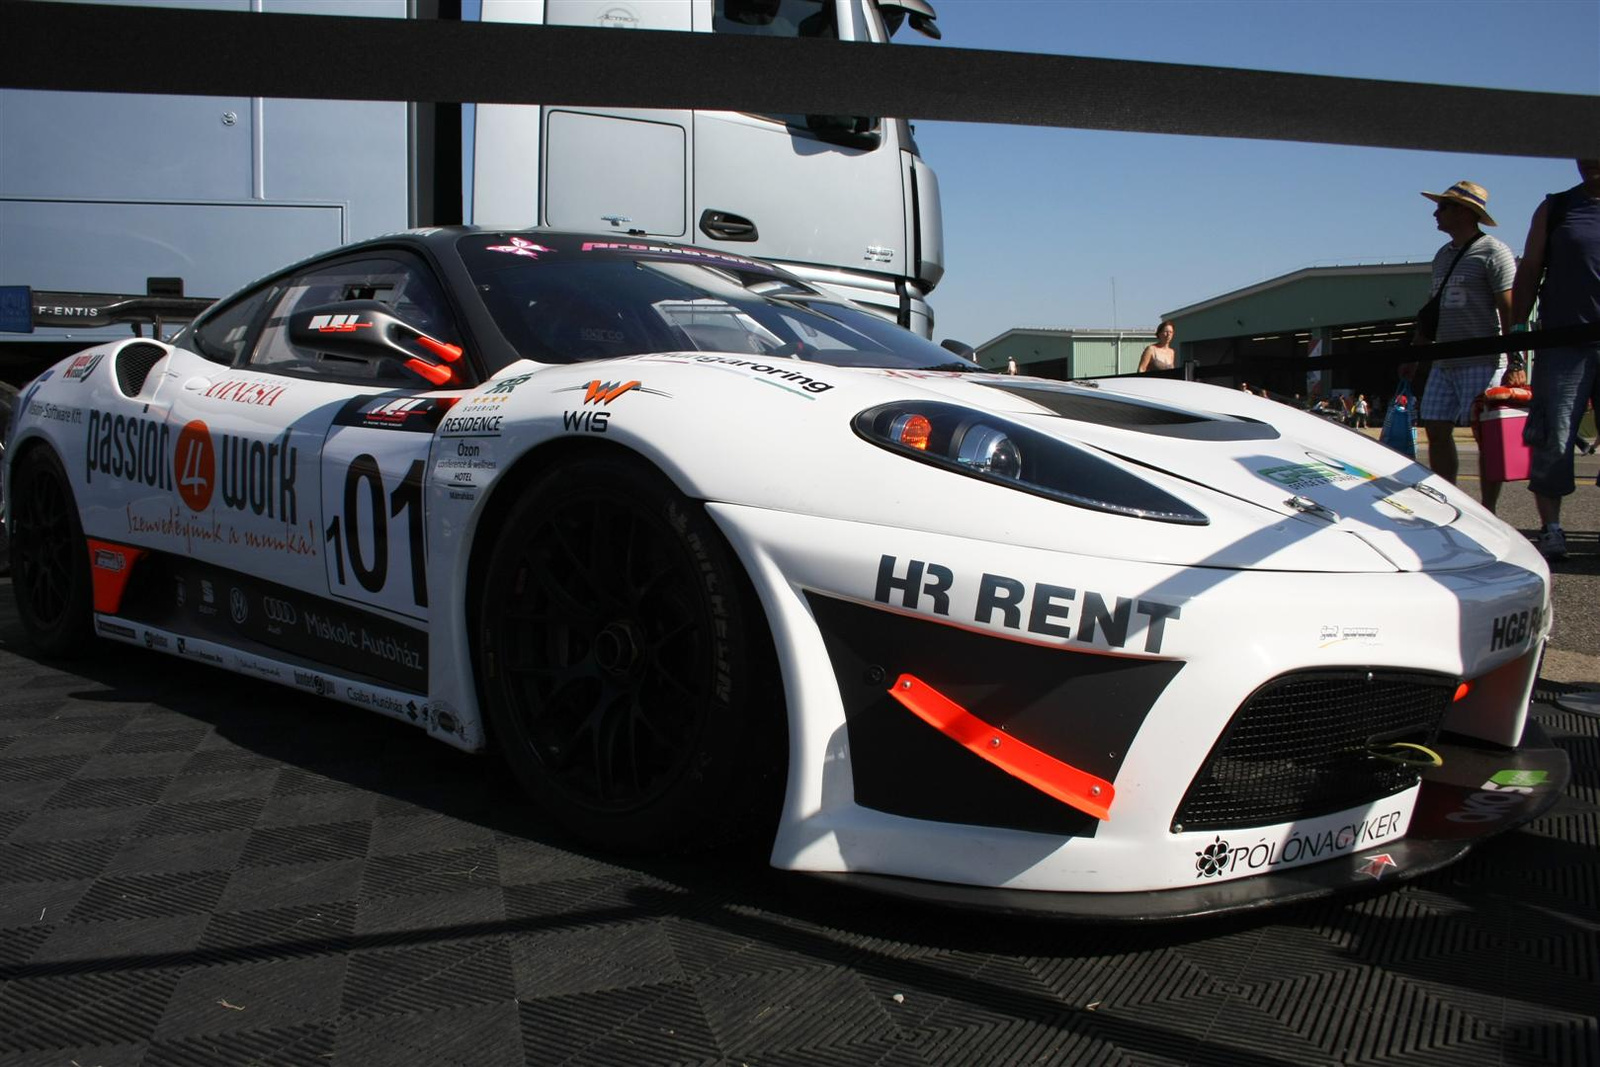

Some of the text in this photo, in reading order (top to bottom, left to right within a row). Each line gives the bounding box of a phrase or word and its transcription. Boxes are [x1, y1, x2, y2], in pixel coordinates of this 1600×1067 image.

[38, 306, 99, 317] F-ENTIS
[443, 416, 502, 433] RESIDENCE
[462, 404, 500, 413] SUPERIOR
[563, 410, 611, 433] WIS
[87, 404, 297, 524] passion 4 work
[457, 439, 480, 458] Ózon
[454, 473, 472, 482] HOTEL
[474, 460, 497, 471] wellness
[245, 515, 316, 557] munka!
[325, 453, 429, 609] 101
[874, 553, 1182, 654] HR RENT
[304, 611, 426, 671] Miskolc Autóház
[1490, 610, 1529, 652] HGB
[1229, 810, 1401, 873] PÓLÓNAGYKER
